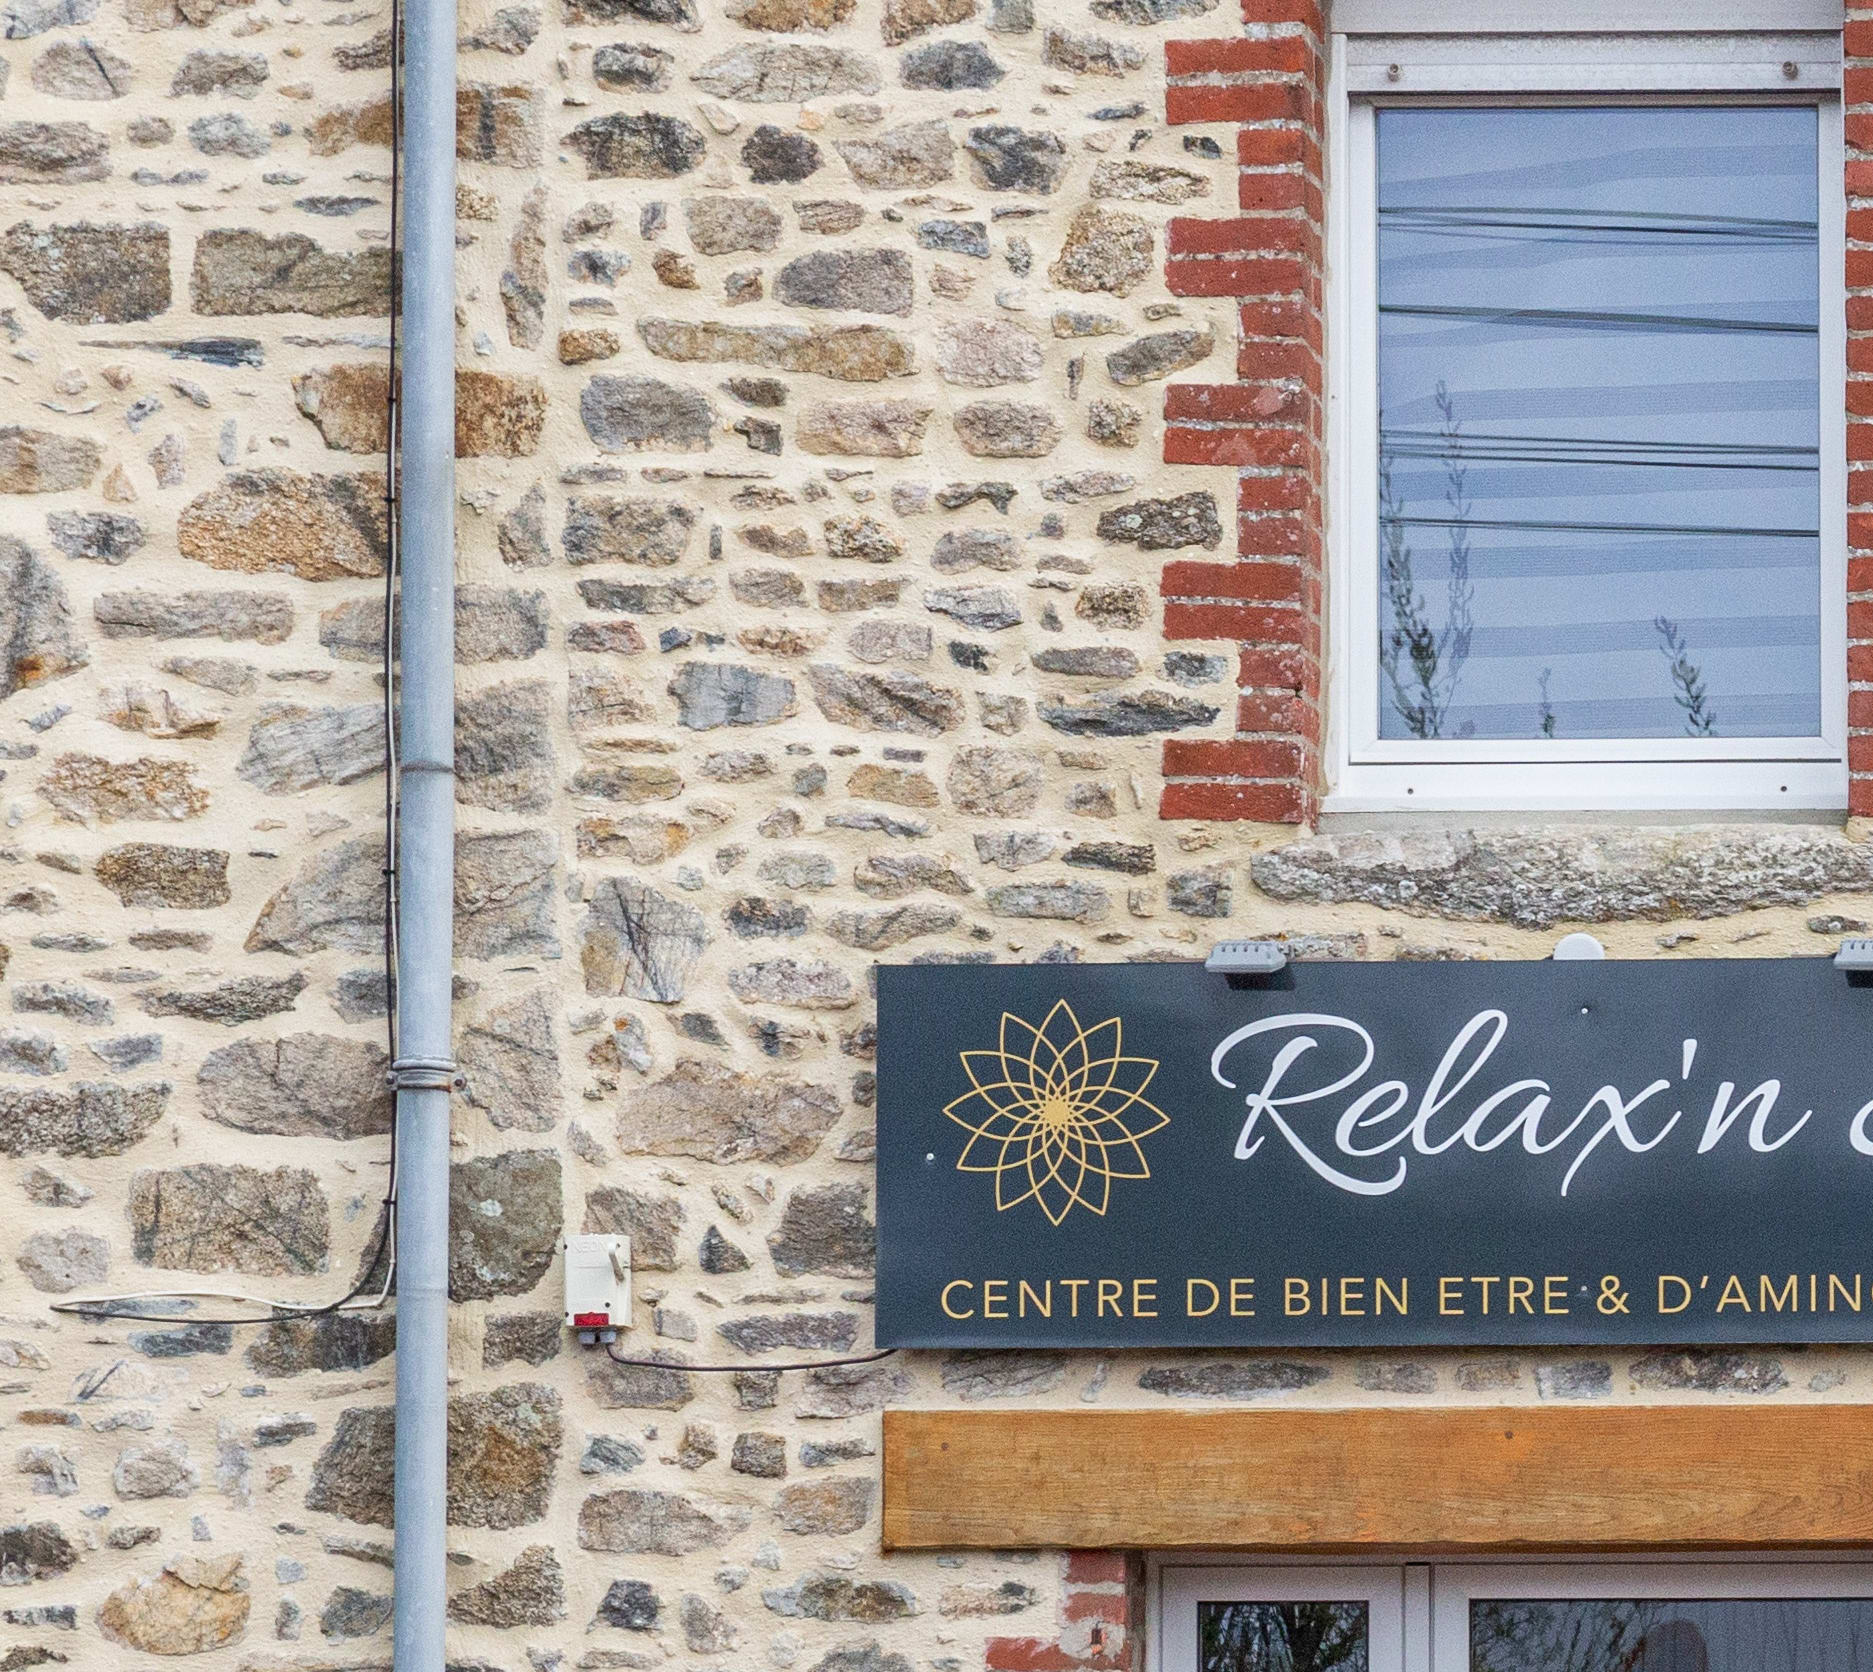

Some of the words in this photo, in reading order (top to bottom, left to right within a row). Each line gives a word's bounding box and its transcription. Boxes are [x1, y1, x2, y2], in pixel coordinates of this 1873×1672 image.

[1209, 1009, 1814, 1197] Relax'n
[941, 1279, 1157, 1319] CENTRE
[1187, 1279, 1254, 1317] DE
[1285, 1278, 1407, 1315] BIEN
[1440, 1276, 1569, 1315] ETRE
[1597, 1275, 1629, 1314] &
